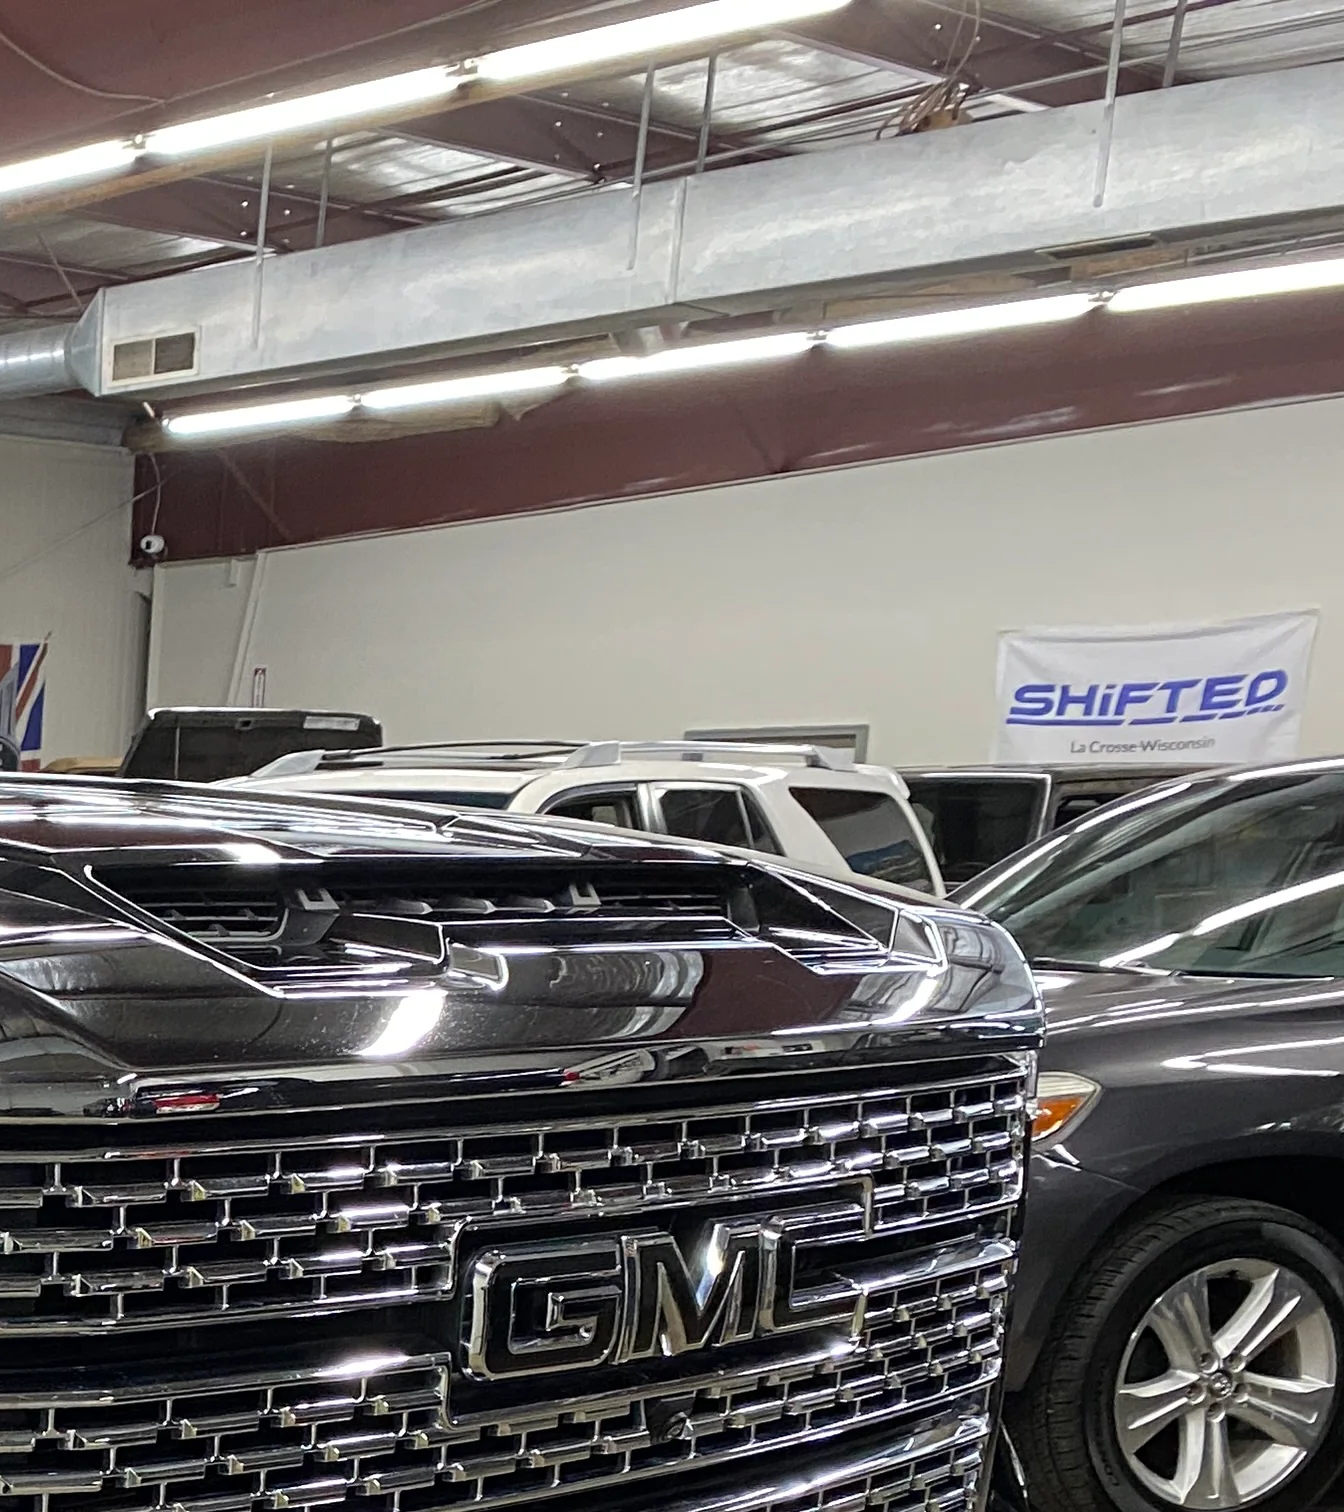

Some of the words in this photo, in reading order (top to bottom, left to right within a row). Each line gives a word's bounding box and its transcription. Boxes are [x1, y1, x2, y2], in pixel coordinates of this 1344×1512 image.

[1009, 669, 1289, 717] SHiFTED
[1070, 740, 1088, 754] La
[462, 1200, 870, 1382] GMC
